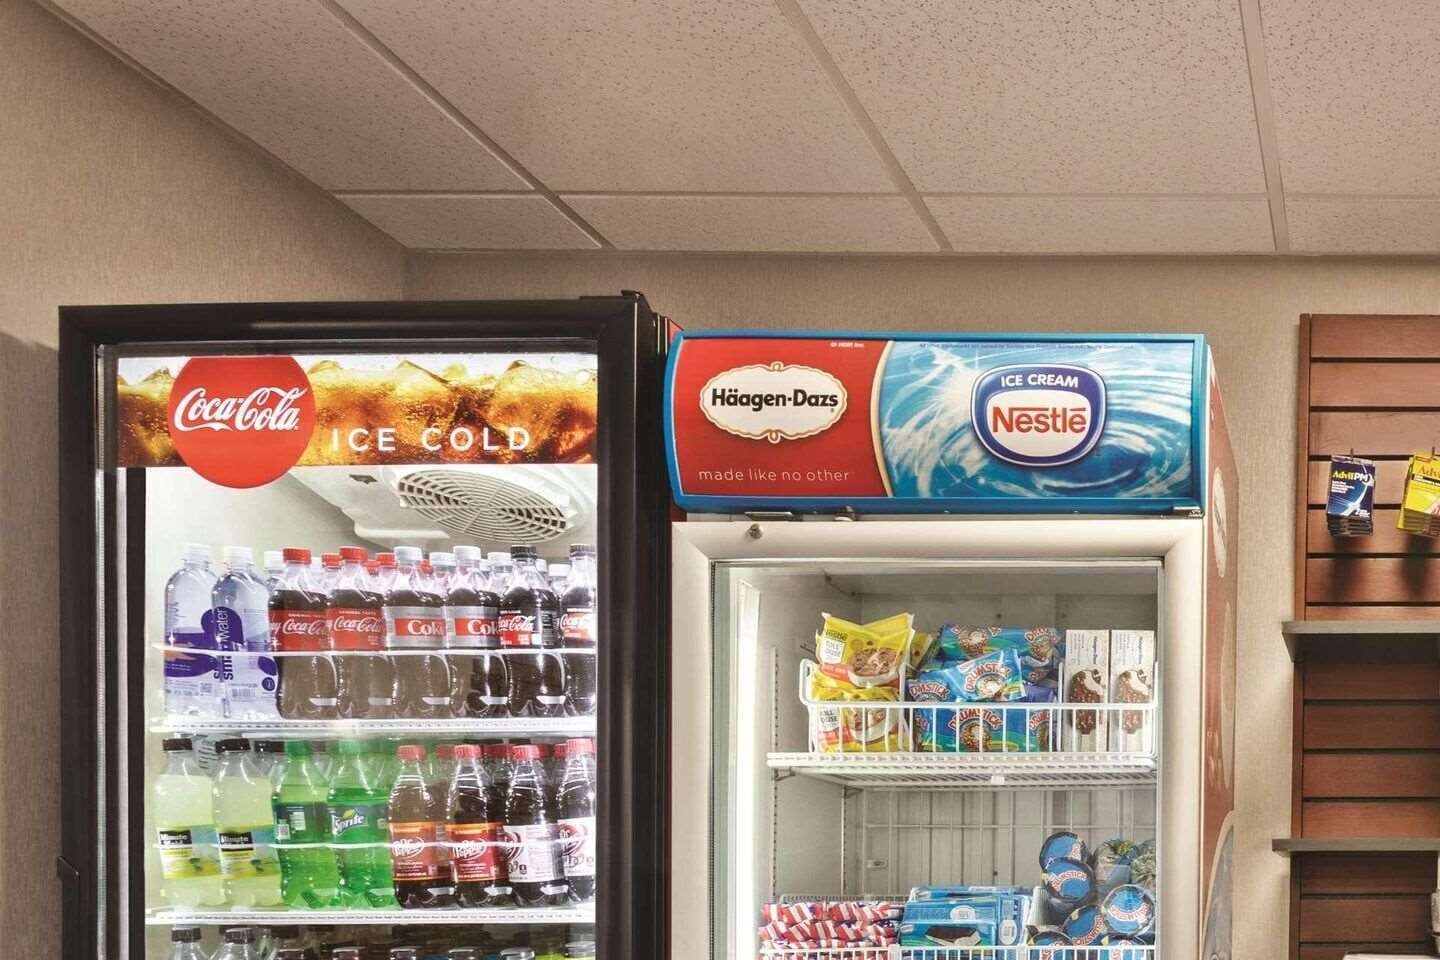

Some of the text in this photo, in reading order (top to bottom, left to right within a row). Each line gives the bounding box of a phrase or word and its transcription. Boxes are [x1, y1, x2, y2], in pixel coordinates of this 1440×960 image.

[1001, 374, 1079, 388] ICE CREAM
[174, 386, 307, 432] Coca-Cola
[711, 388, 838, 411] Häagen-Dazs
[992, 407, 1086, 433] Nestlé
[332, 426, 531, 451] ICE COLD
[699, 468, 850, 482] made like no other
[1354, 472, 1369, 481] PM
[467, 620, 499, 635] Cok
[334, 813, 365, 832] Sprite
